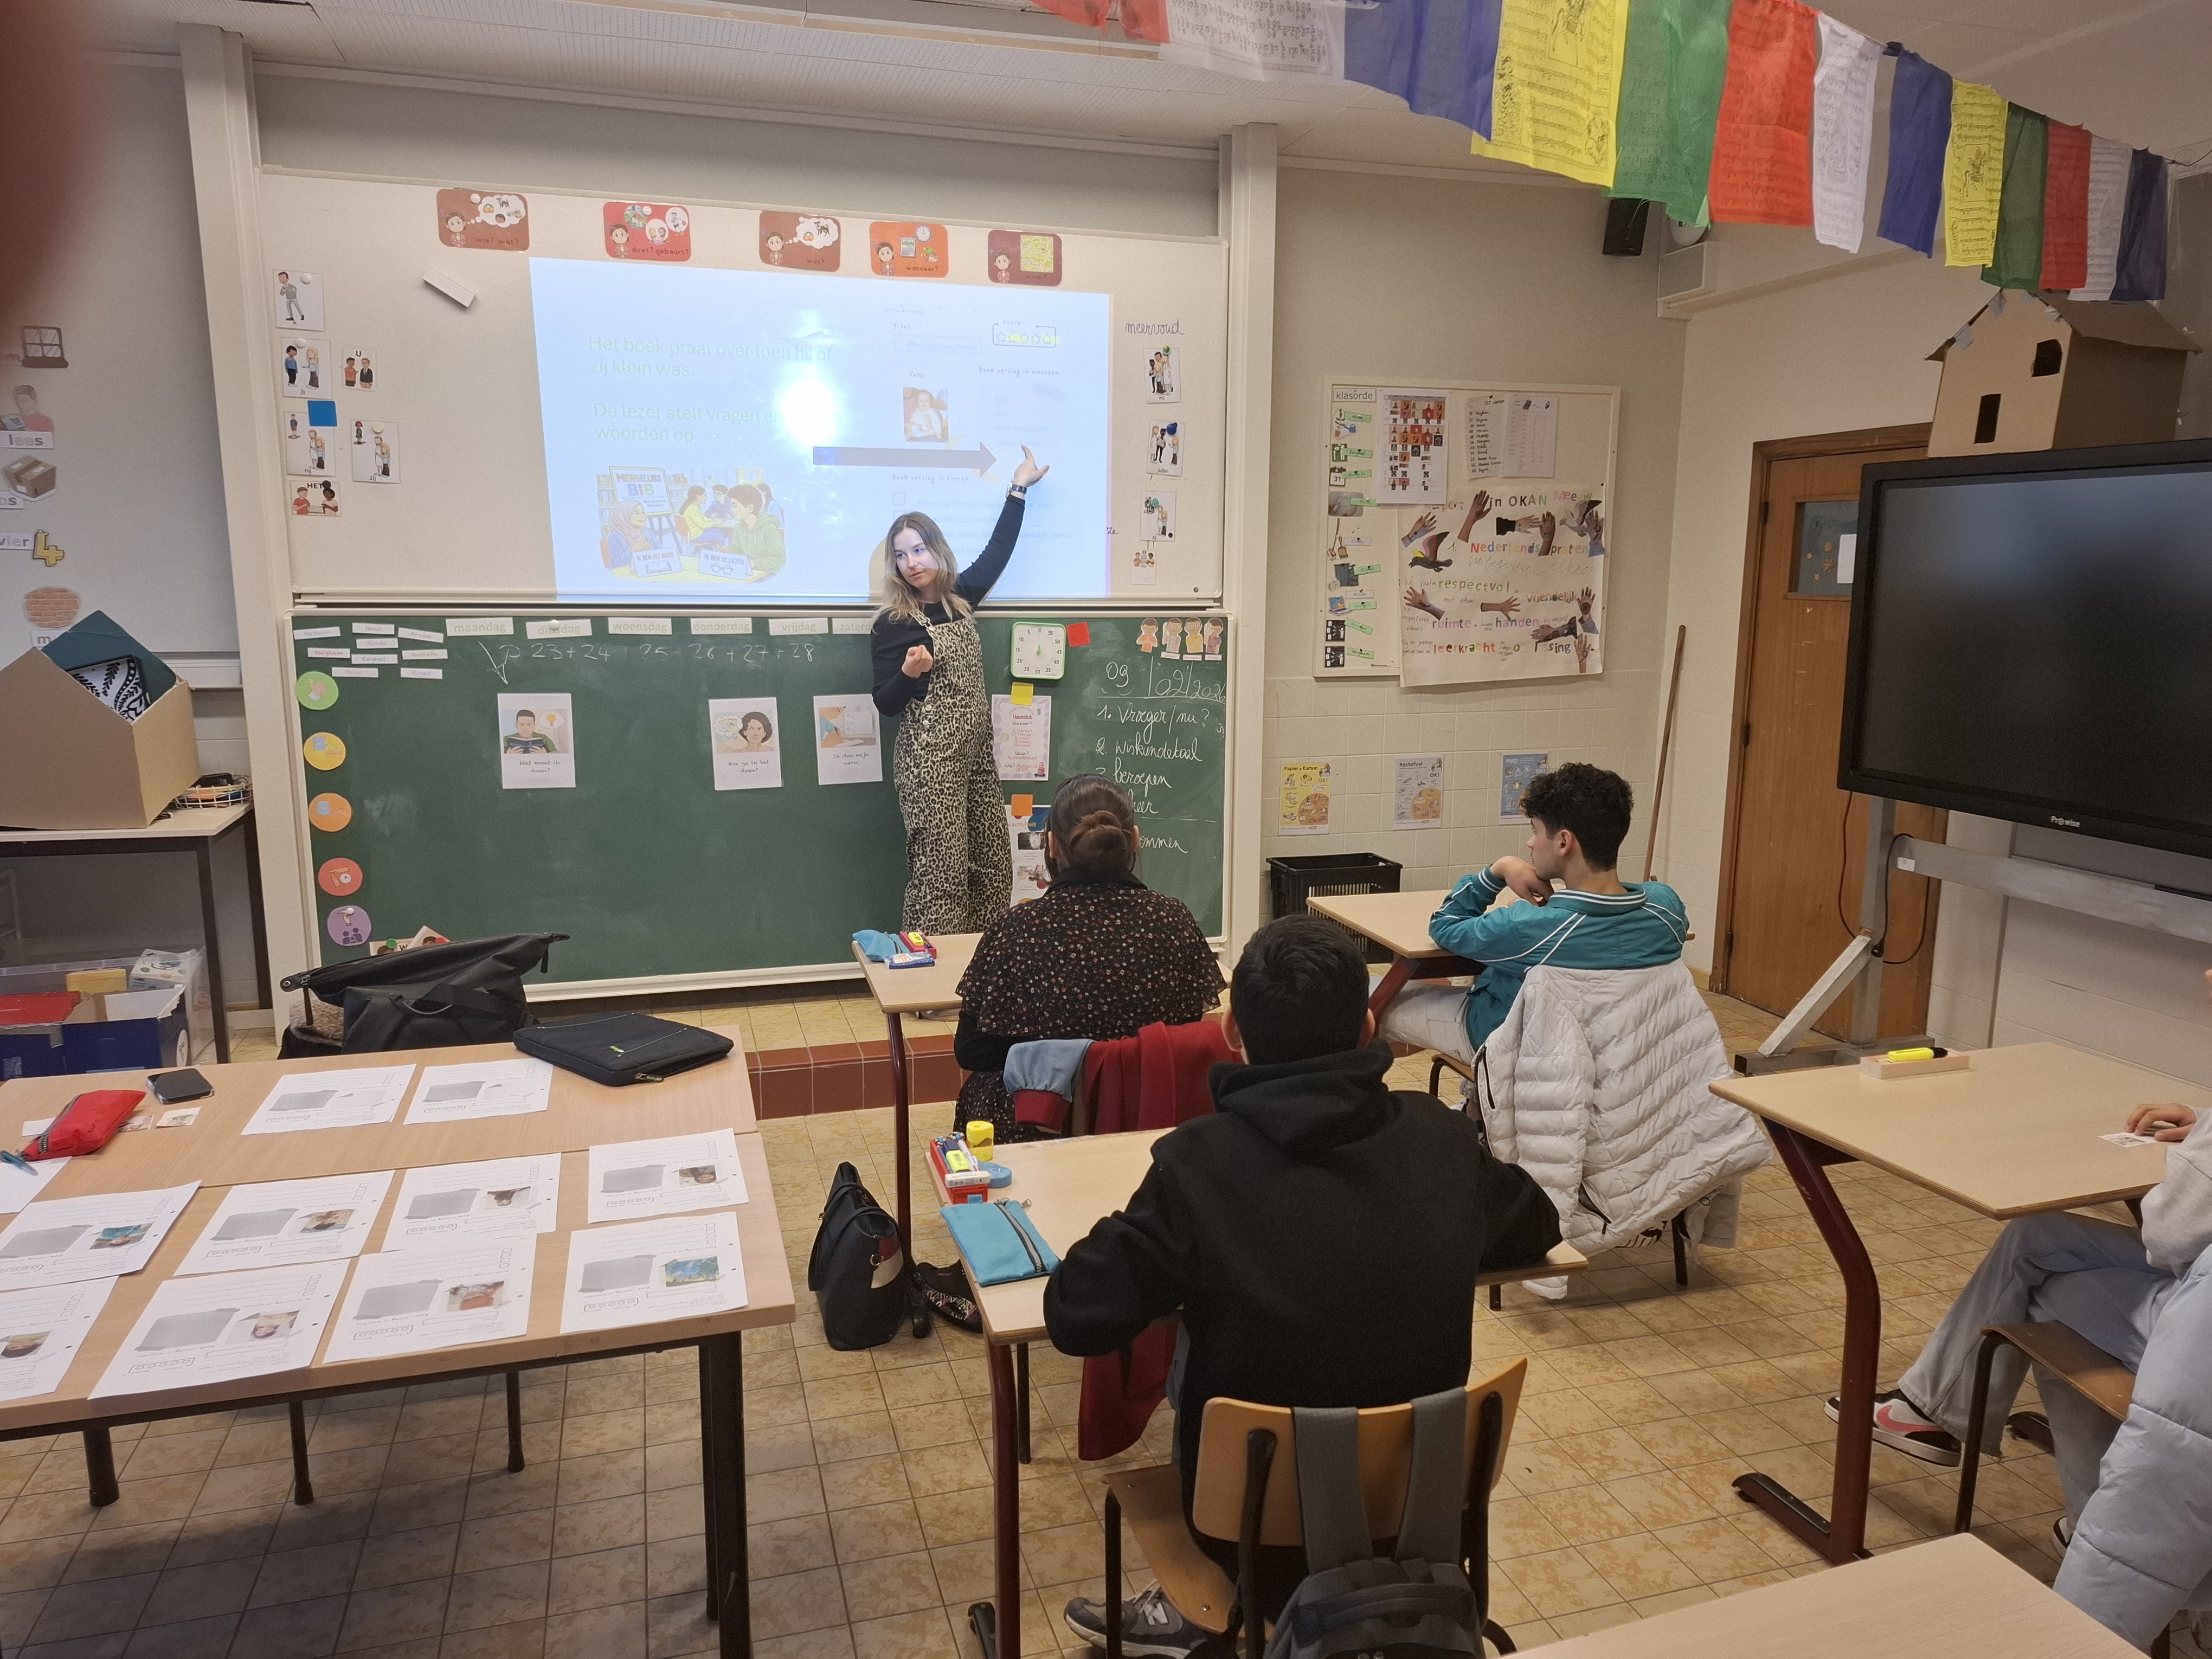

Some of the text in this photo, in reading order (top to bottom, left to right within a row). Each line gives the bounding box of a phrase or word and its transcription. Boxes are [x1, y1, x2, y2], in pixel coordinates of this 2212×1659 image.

[475, 237, 519, 246] wie? wat?
[632, 246, 689, 257] doet? gebeurt?
[806, 258, 825, 266] wat?
[1125, 318, 1185, 336] meervoud
[589, 336, 619, 351] Het
[624, 338, 665, 354] boek
[670, 341, 712, 357] praat
[716, 345, 750, 357] over
[755, 345, 790, 359] toen
[817, 347, 832, 362] of
[589, 358, 695, 377] zij klein was.
[996, 367, 1020, 378] verslag
[1336, 390, 1373, 400] klasorde
[594, 402, 617, 418] De
[622, 404, 663, 419] lezer
[666, 407, 703, 421] stelt
[707, 409, 760, 425] vragen
[8, 434, 44, 447] lees
[595, 427, 698, 444] woorden op.
[910, 475, 935, 484] verslag
[627, 483, 655, 497] BIB
[1489, 494, 1502, 508] in
[1508, 494, 1547, 507] OKAN
[728, 557, 745, 565] LEZER
[1438, 578, 1510, 594] respectvol
[454, 621, 506, 633] maandag
[612, 621, 667, 633] woensdag
[693, 622, 750, 632] donderdag
[781, 622, 816, 633] vrijdag
[840, 621, 871, 631] zaterd
[1495, 616, 1539, 628] handen
[410, 631, 432, 639] Arzoo
[1433, 642, 1496, 655] leerkracht
